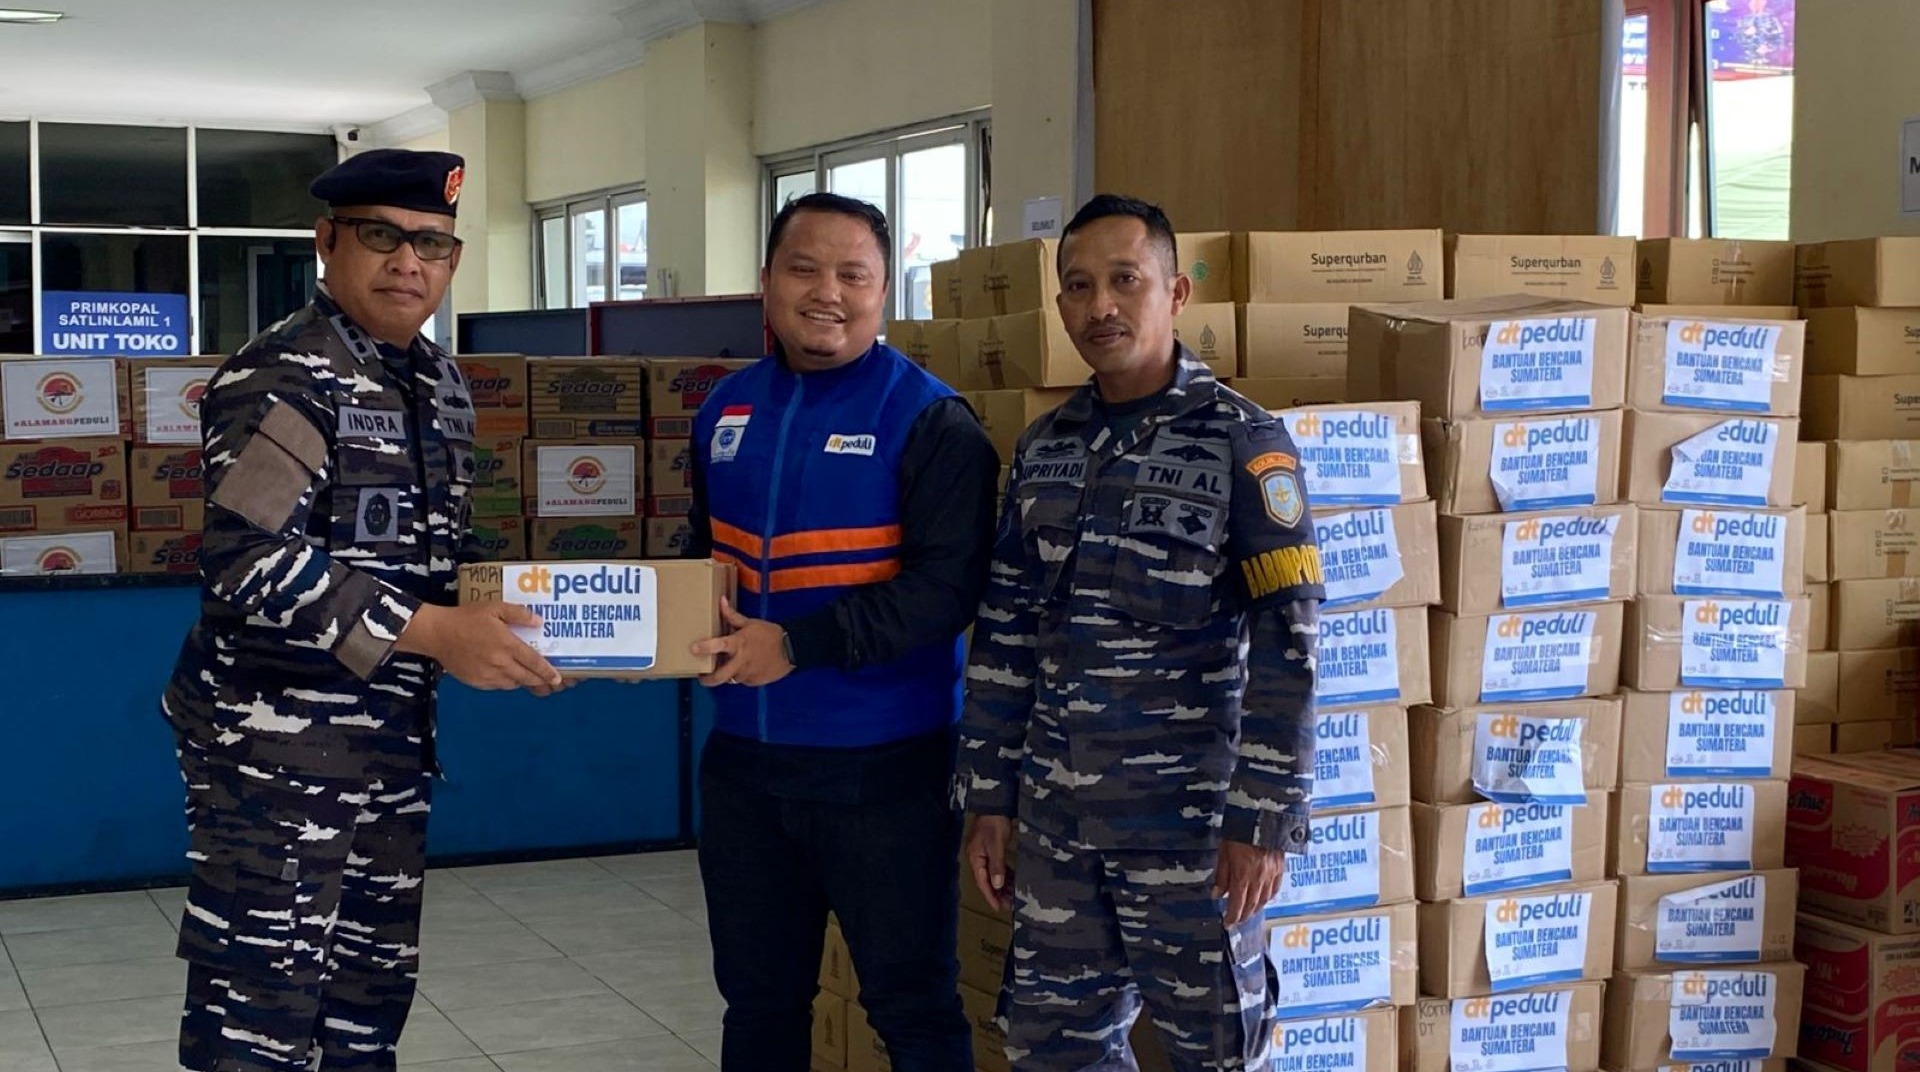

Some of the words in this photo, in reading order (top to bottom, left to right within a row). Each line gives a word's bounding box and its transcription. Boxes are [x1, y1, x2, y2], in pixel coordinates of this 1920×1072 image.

[1311, 252, 1387, 268] Superqurban
[1510, 256, 1581, 270] Superqurban
[70, 301, 160, 314] PRIMKOPAL
[58, 314, 159, 327] SATLINLAMIL
[163, 316, 171, 327] 1
[1303, 324, 1349, 338] Superqu
[1497, 318, 1585, 350] dtpeduli
[1679, 322, 1768, 351] dtpeduli
[53, 332, 109, 350] UNIT
[114, 334, 178, 351] TOKO
[1492, 353, 1536, 369] BANTUAN
[1538, 350, 1582, 366] BENCANA
[1676, 352, 1720, 368] BANTUAN
[1721, 355, 1763, 373] BENCANA
[469, 375, 512, 392] aap
[669, 376, 712, 393] Sed
[1510, 367, 1562, 383] SUMATERA
[1693, 368, 1744, 386] SUMATERA
[547, 378, 627, 396] Sedaap
[14, 416, 110, 427] #ALAMANGPEDULI
[348, 413, 399, 433] INDRA
[1295, 412, 1389, 445] dtpeduli
[1504, 418, 1589, 452] dtpeduli
[1718, 419, 1768, 445] eduli
[1344, 448, 1389, 463] BENCANA
[1501, 453, 1543, 471] BANTUAN
[1545, 450, 1588, 468] BENCANA
[1721, 451, 1763, 467] BENCANA
[5, 461, 104, 479] Sedaap
[154, 464, 203, 481] Sed
[1022, 462, 1084, 480] UPRIYADI
[1148, 465, 1183, 486] TNI
[1193, 471, 1222, 494] AL
[1317, 463, 1371, 478] SUMATERA
[1517, 467, 1568, 485] SUMATERA
[1694, 464, 1743, 480] SUMATERA
[1317, 511, 1385, 549] peduli
[1692, 512, 1777, 541] dtpeduli
[1342, 544, 1388, 565] BENCANA
[1512, 548, 1556, 565] BANTUAN
[1558, 543, 1601, 561] BENCANA
[1687, 541, 1730, 557] BANTUAN
[1732, 544, 1775, 562] BENCANA
[1240, 543, 1326, 600] BABINPOT
[1531, 561, 1582, 579] SUMATERA
[1704, 558, 1755, 575] SUMATERA
[518, 565, 641, 601] dtpeduli
[581, 604, 641, 621] BENCANA
[1695, 601, 1780, 631] dtpeduli
[543, 621, 615, 639] SUMATERA
[1318, 611, 1387, 646] peduli
[1497, 613, 1586, 644] dtpeduli
[1341, 643, 1387, 661] BENCANA
[1494, 644, 1537, 662] BANTUAN
[1539, 642, 1581, 658] BENCANA
[1710, 648, 1759, 663] SUMATERA
[1319, 660, 1368, 679] UMATERA
[1511, 658, 1561, 675] SUMATERA
[1681, 690, 1766, 721] dtpeduli
[1317, 714, 1359, 739] duli
[1490, 715, 1577, 746] dtpeduli
[1678, 723, 1721, 738] BANTUAN
[1723, 723, 1765, 738] BENCANA
[1695, 737, 1747, 752] SUMATERA
[1486, 746, 1536, 763] BANTUA
[1314, 765, 1341, 781] TERA
[1660, 785, 1744, 815] dtpeduli
[1311, 816, 1366, 844] eduli
[1659, 817, 1701, 832] BANTUAN
[1702, 816, 1743, 832] BENCANA
[1475, 833, 1518, 853] BANTUAN
[1520, 826, 1563, 844] BENCANA
[1675, 832, 1726, 846] SUMATERA
[1286, 854, 1317, 873] TUAN
[1320, 848, 1367, 868] BENCANA
[1493, 844, 1544, 865] SUMATERA
[1290, 867, 1348, 888] SUMATERA
[1496, 894, 1583, 928] dtpeduli
[1283, 918, 1380, 954] dtpeduli
[1495, 928, 1535, 948] BANTUAN
[1536, 925, 1578, 942] BENCANA
[1685, 922, 1736, 937] SUMATERA
[1512, 941, 1558, 962] SUMATERA
[1282, 955, 1330, 974] BANTUAN
[1303, 968, 1360, 988] SUMATERA
[1683, 973, 1767, 1004] dtpeduli
[1463, 992, 1559, 1024] dtpeduli
[1679, 1005, 1722, 1021] BANTUAN
[1724, 1005, 1765, 1020] BENCANA
[1272, 1018, 1354, 1054] tpeduli
[1461, 1025, 1508, 1043] BANTUAN
[1510, 1021, 1556, 1038] BENCANA
[1698, 1021, 1750, 1035] SUMATERA
[1481, 1038, 1535, 1056] SUMATERA
[1271, 1055, 1306, 1072] NTUAN
[1306, 1052, 1354, 1068] BENCANA
